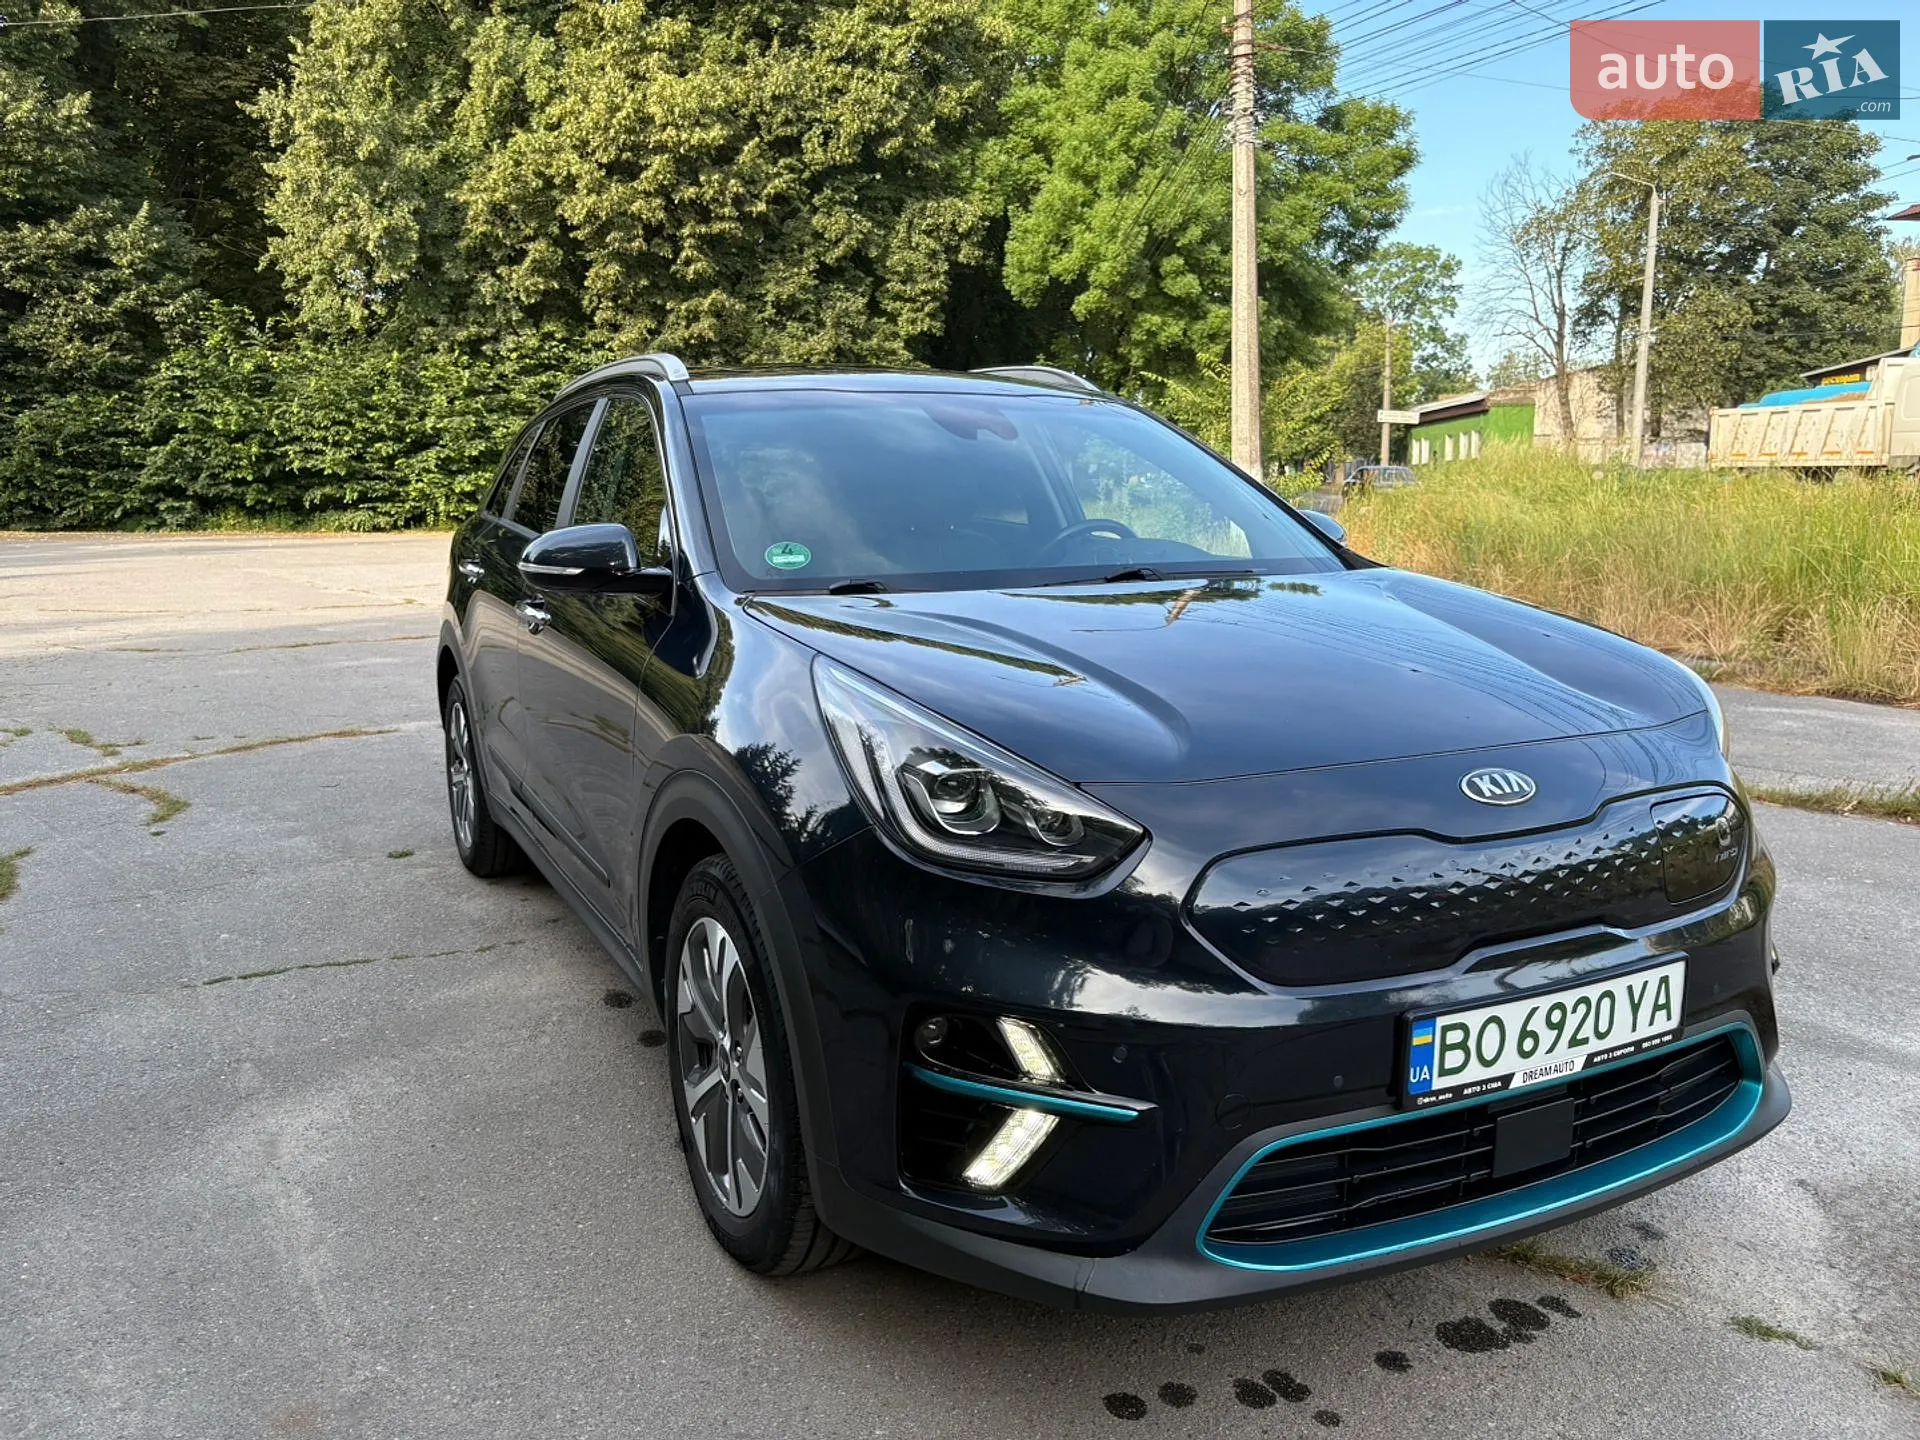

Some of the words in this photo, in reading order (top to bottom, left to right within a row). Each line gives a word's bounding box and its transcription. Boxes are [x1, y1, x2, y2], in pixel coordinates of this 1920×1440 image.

[1471, 772, 1531, 798] KIA
[1438, 1014, 1507, 1078] BO
[1516, 989, 1617, 1060] 6920
[1626, 974, 1673, 1033] YA
[1410, 1065, 1431, 1084] UA
